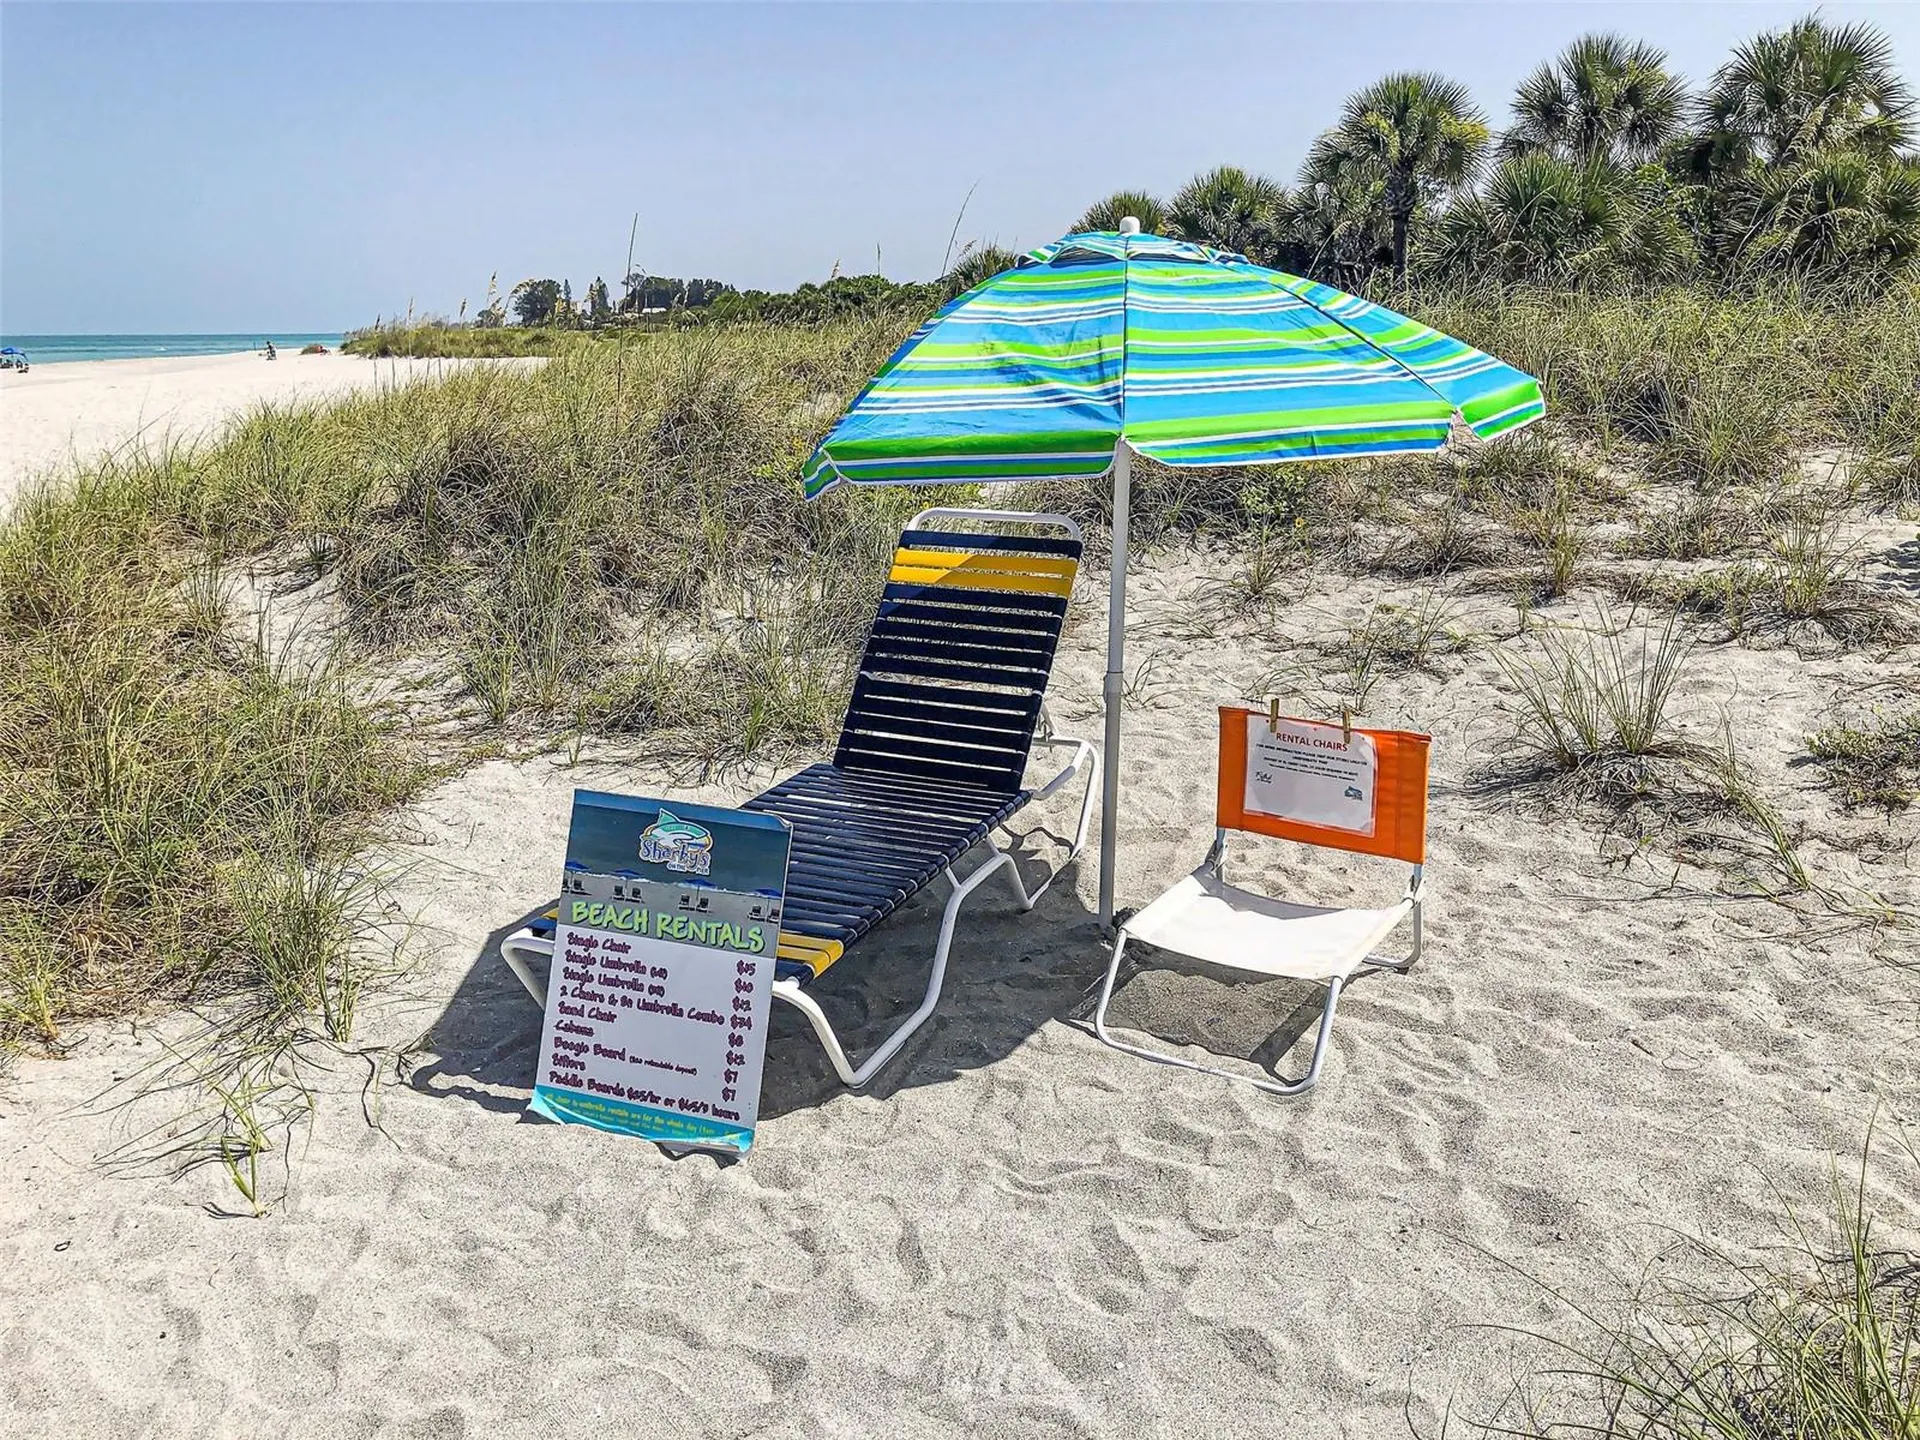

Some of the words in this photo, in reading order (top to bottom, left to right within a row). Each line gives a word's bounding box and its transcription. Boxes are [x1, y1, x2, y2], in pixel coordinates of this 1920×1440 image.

[1276, 732, 1311, 746] RENTAL
[1313, 738, 1348, 752] CHAIRS
[641, 838, 710, 869] Sharky's
[566, 932, 599, 952] Single
[602, 938, 632, 954] Chair
[571, 900, 650, 934] BEACH
[656, 912, 766, 953] RENTALS
[562, 966, 595, 987] Single
[598, 973, 644, 992] Umbrella
[732, 996, 752, 1012] $12
[564, 949, 597, 970] Single
[600, 956, 648, 975] Umbrella
[734, 978, 754, 994] $10
[558, 1000, 584, 1018] Sand
[588, 1006, 617, 1024] Chair
[560, 985, 568, 997] 2
[570, 986, 605, 1003] Chairs
[608, 994, 618, 1006] &
[636, 998, 684, 1018] Umbrella
[687, 1008, 725, 1026] Combo
[554, 1036, 590, 1057] Boogie
[594, 1043, 626, 1062] Board
[724, 1068, 738, 1084] $7
[726, 1050, 746, 1066] $12
[549, 1070, 584, 1088] Paddle
[587, 1078, 626, 1097] Boards
[664, 1098, 676, 1108] or
[712, 1104, 740, 1122] hours
[722, 1086, 736, 1102] $7
